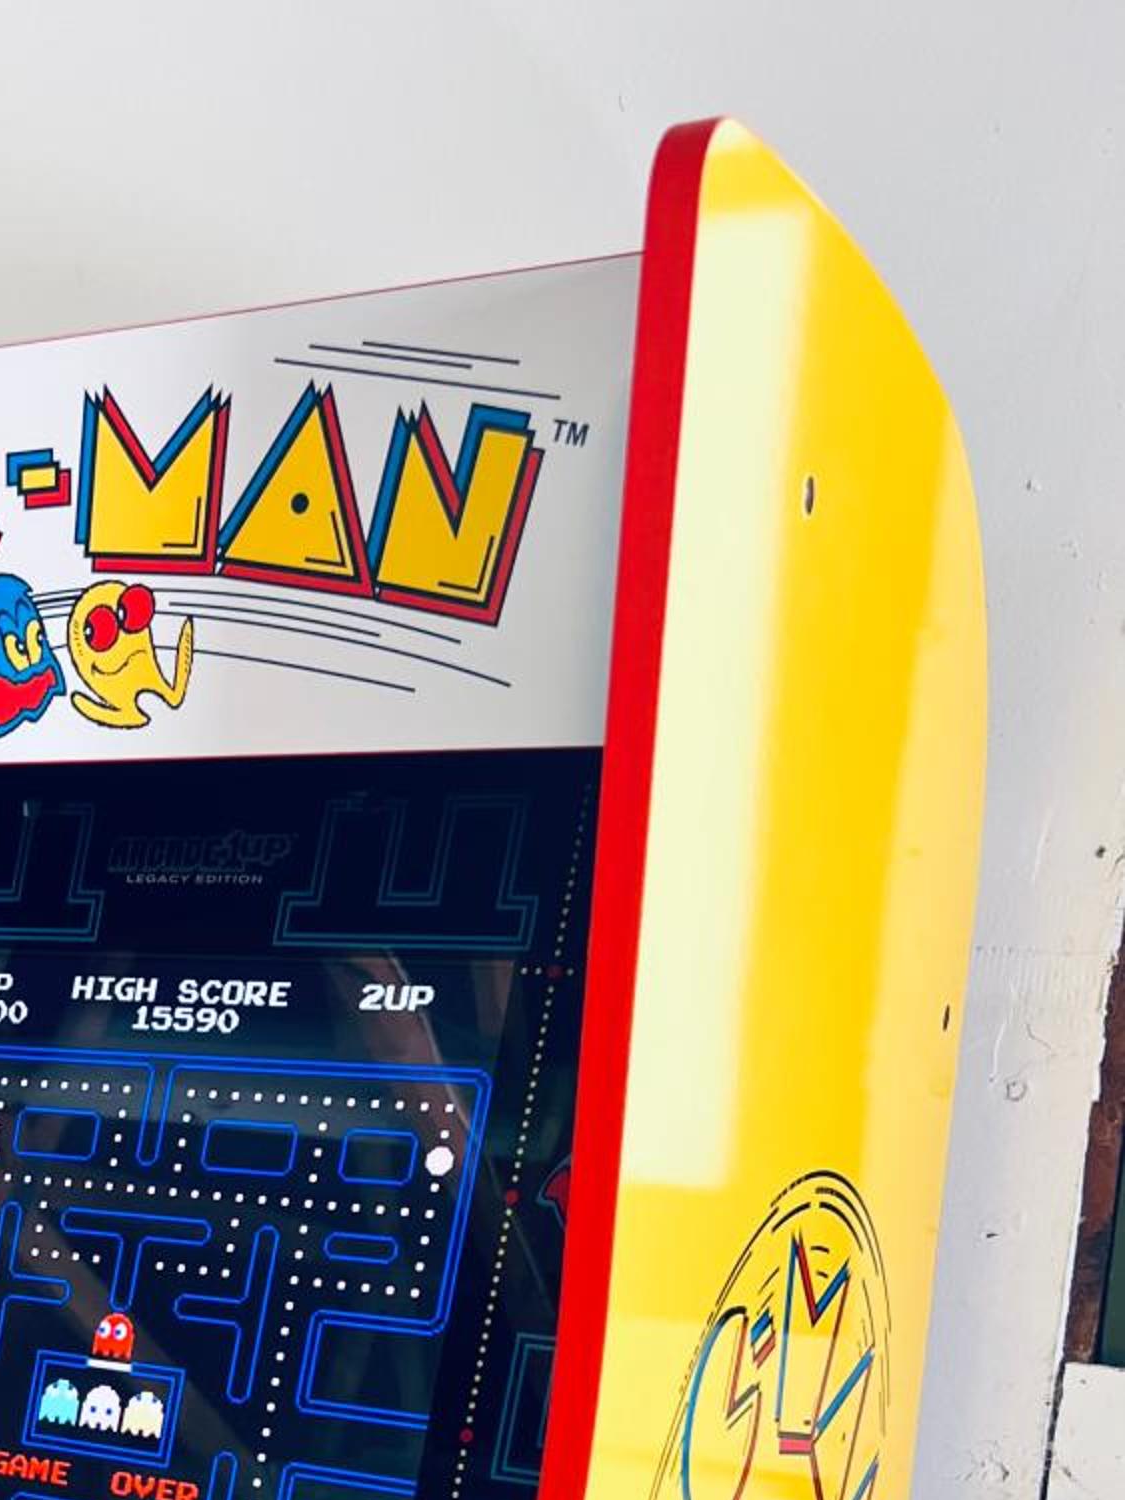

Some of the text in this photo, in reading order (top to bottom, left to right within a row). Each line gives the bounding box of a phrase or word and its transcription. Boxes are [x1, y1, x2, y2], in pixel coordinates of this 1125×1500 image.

[553, 418, 589, 447] TM
[126, 873, 264, 885] LEGACY EDITION
[71, 975, 158, 1003] HIGH
[177, 979, 292, 1008] SCORE
[359, 983, 435, 1012] 2UP
[131, 1005, 240, 1034] 15590
